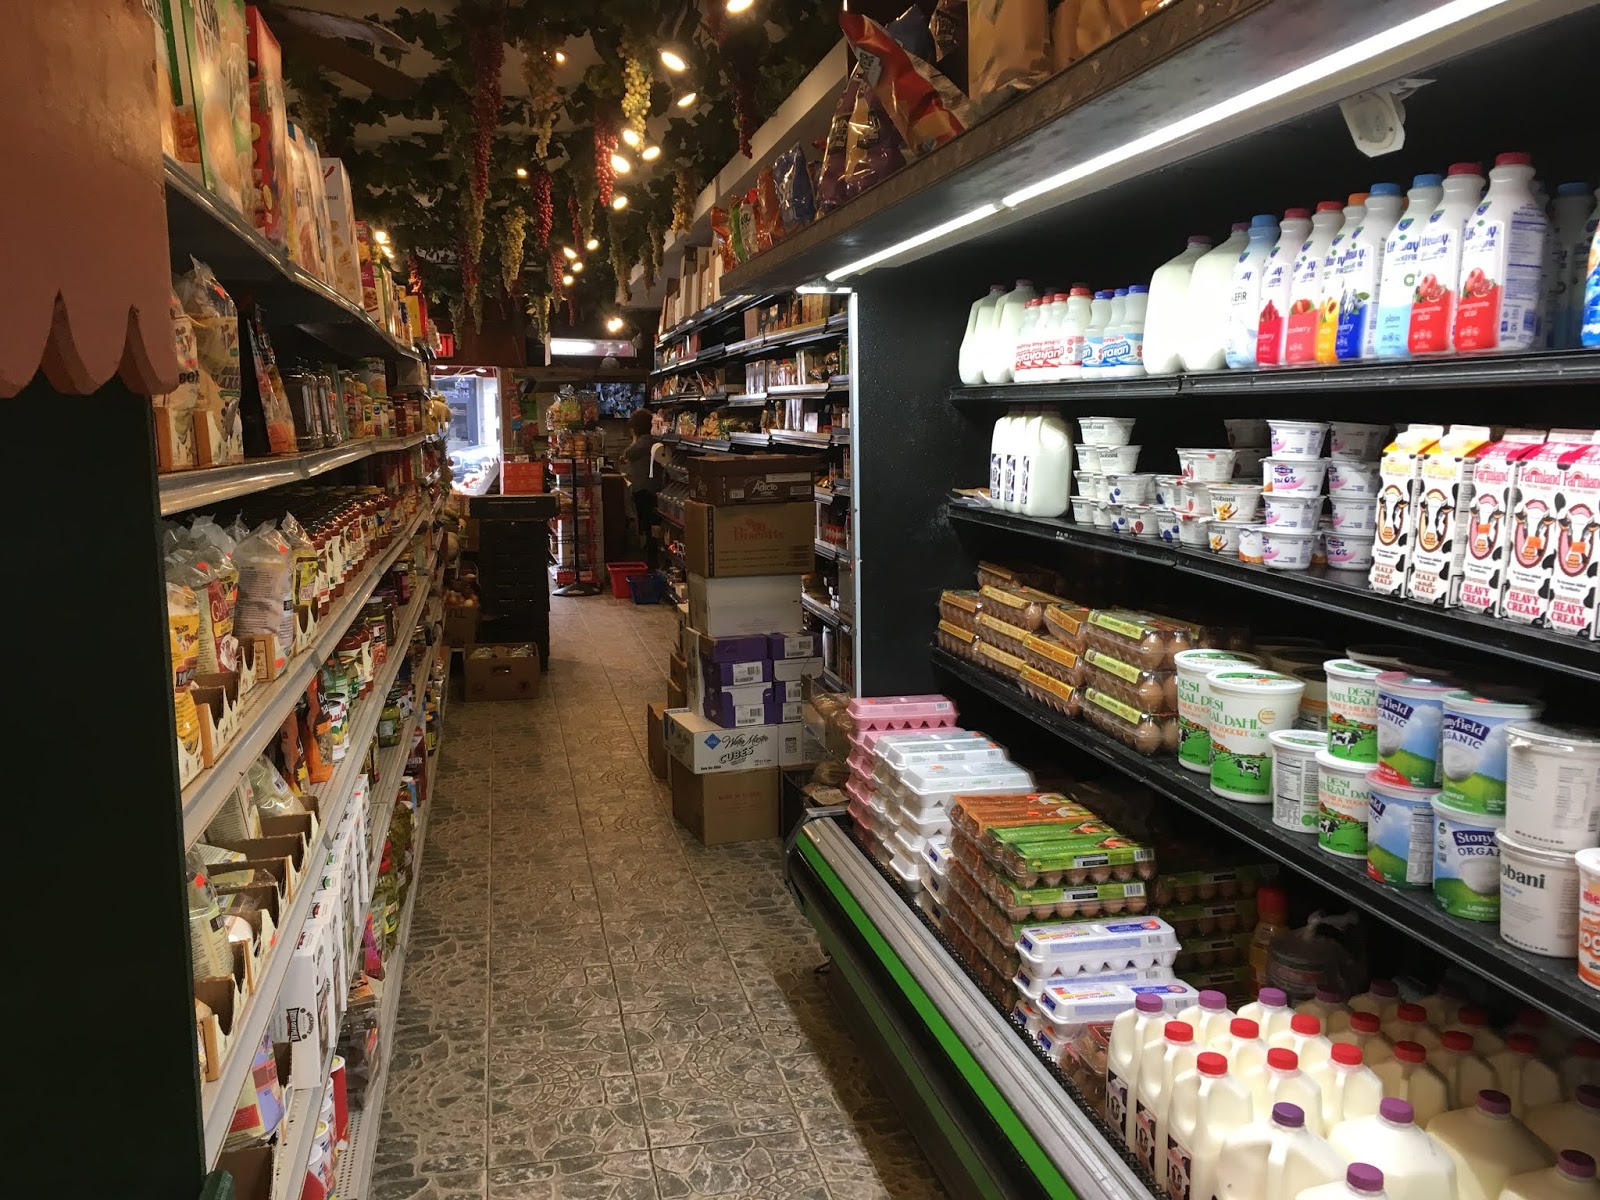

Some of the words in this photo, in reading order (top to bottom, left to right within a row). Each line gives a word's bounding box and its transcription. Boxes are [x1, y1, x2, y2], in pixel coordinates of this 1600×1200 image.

[1520, 467, 1562, 486] Farmland
[1563, 471, 1600, 489] Farmlan
[1375, 565, 1394, 575] HALF
[1374, 576, 1394, 586] HALF
[1415, 573, 1437, 583] HALF
[1414, 584, 1437, 595] HALF
[1463, 583, 1491, 597] HEAVY
[1461, 593, 1491, 607] CREAM
[1509, 591, 1540, 606] HEAVY
[1506, 601, 1541, 617] CREAM
[1553, 600, 1585, 616] HEAVY
[1551, 611, 1586, 627] CREAM
[1347, 686, 1376, 698] DESI
[720, 746, 754, 765] CUBES
[1326, 775, 1350, 789] DESI
[1456, 832, 1494, 846] Stony
